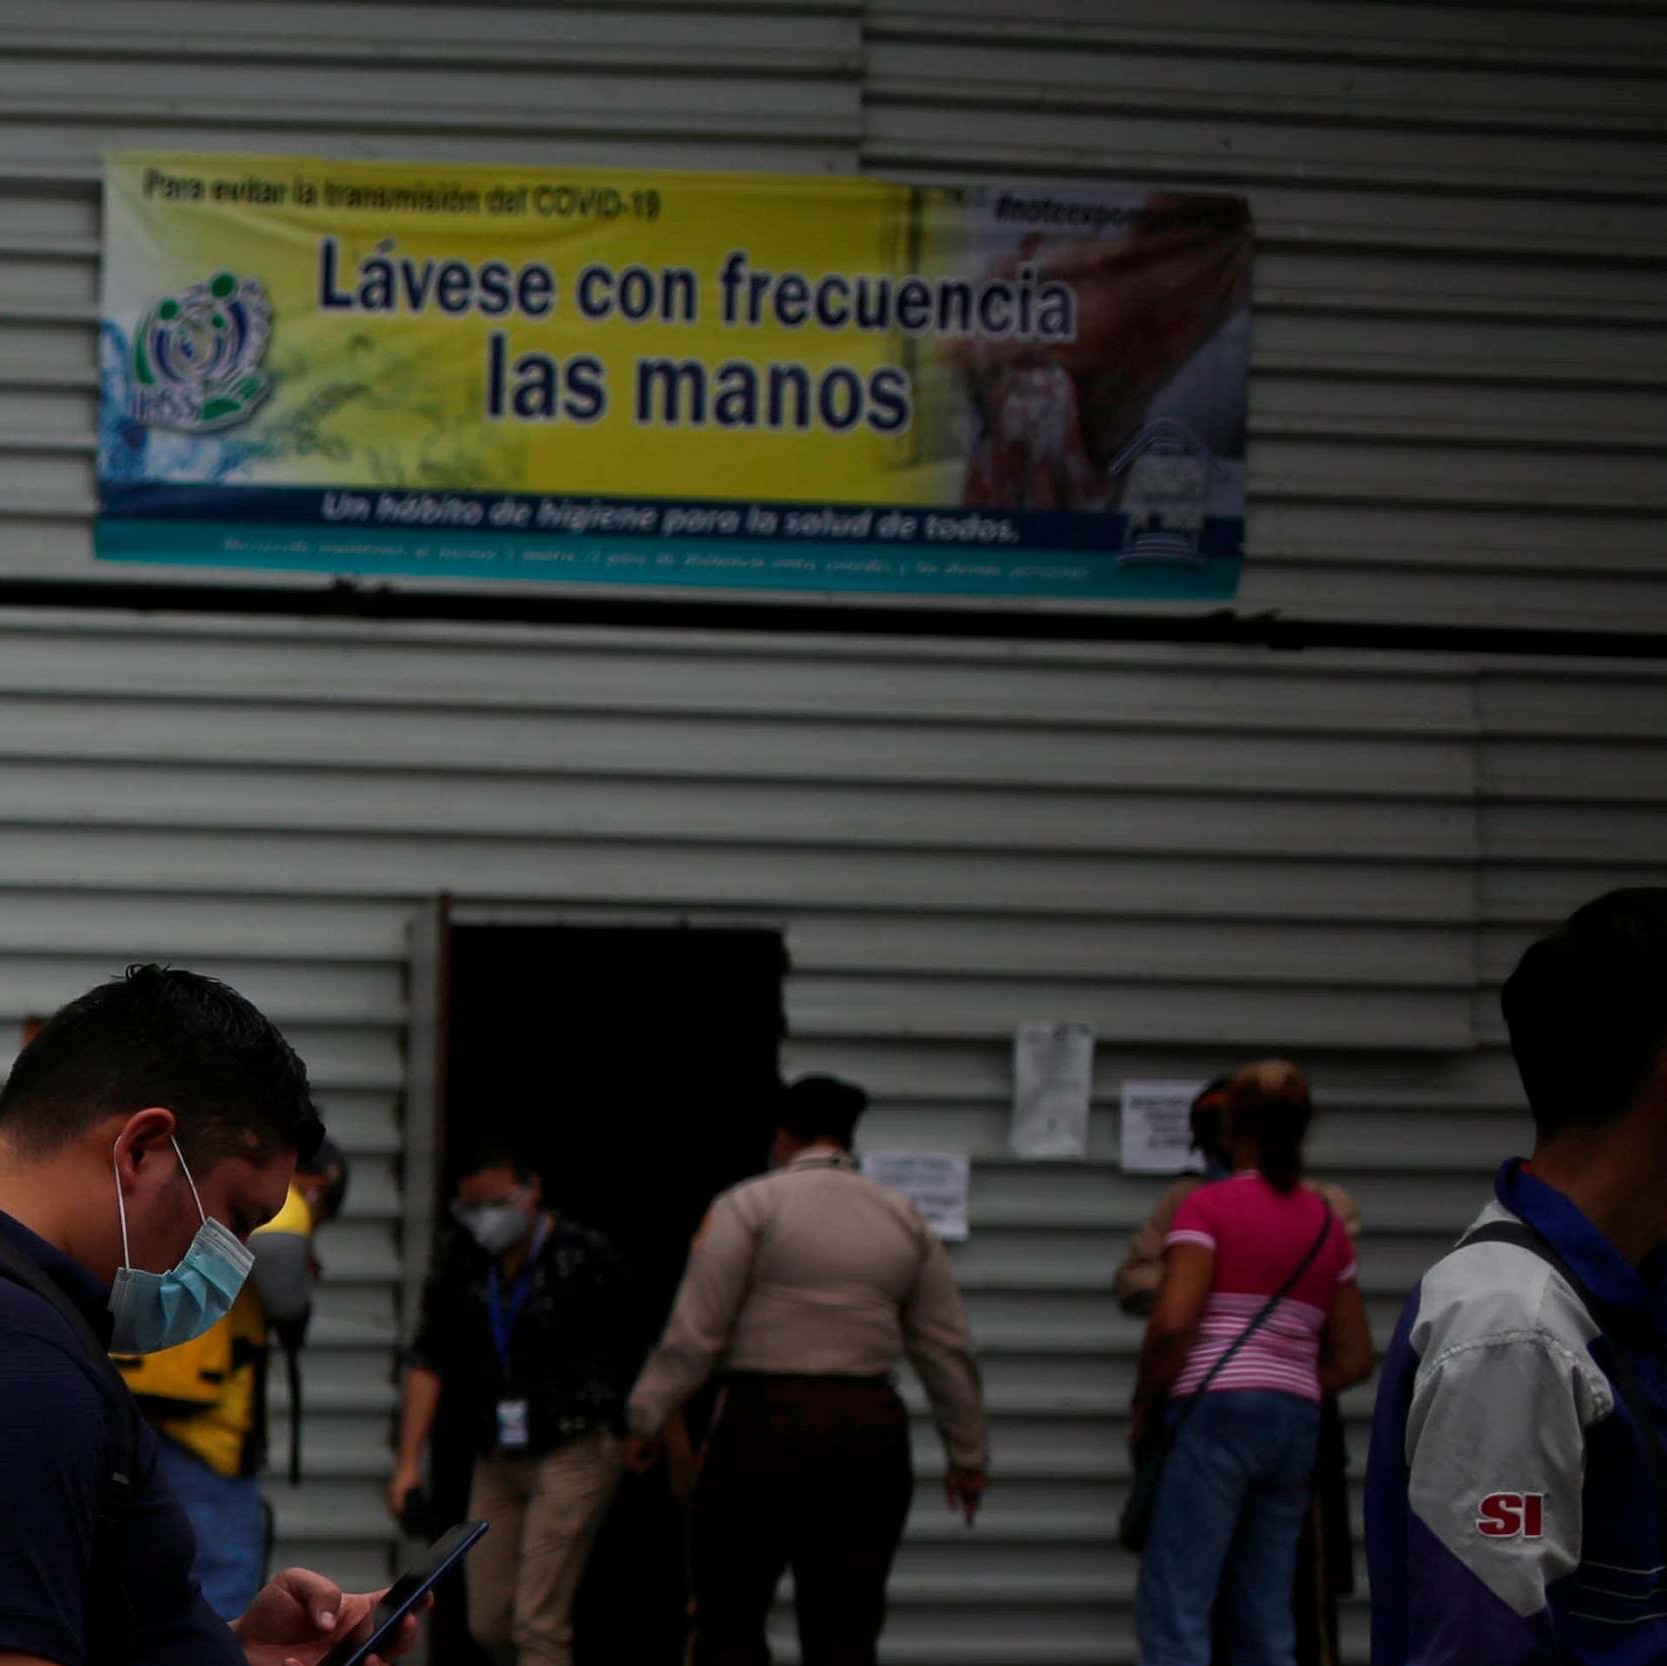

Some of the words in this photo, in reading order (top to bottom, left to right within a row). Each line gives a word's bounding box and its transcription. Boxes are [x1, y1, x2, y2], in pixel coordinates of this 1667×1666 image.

[143, 169, 205, 201] Para
[210, 173, 286, 205] evitar
[296, 176, 318, 206] la
[323, 178, 481, 213] transmisión
[486, 185, 526, 214] del
[533, 184, 661, 220] COVID-19
[320, 236, 555, 317] Lávese
[578, 265, 697, 321] con
[720, 250, 1075, 341] frecuencia
[485, 334, 607, 422] las
[635, 357, 913, 436] manos
[321, 491, 372, 523] Un
[375, 492, 485, 527] hábito
[489, 497, 533, 528] de
[536, 498, 658, 534] higiene
[660, 506, 742, 538] para
[745, 505, 780, 536] la
[783, 508, 874, 539] salud
[875, 511, 920, 540] de
[924, 512, 1020, 544] todos.
[1475, 1491, 1546, 1540] SI
